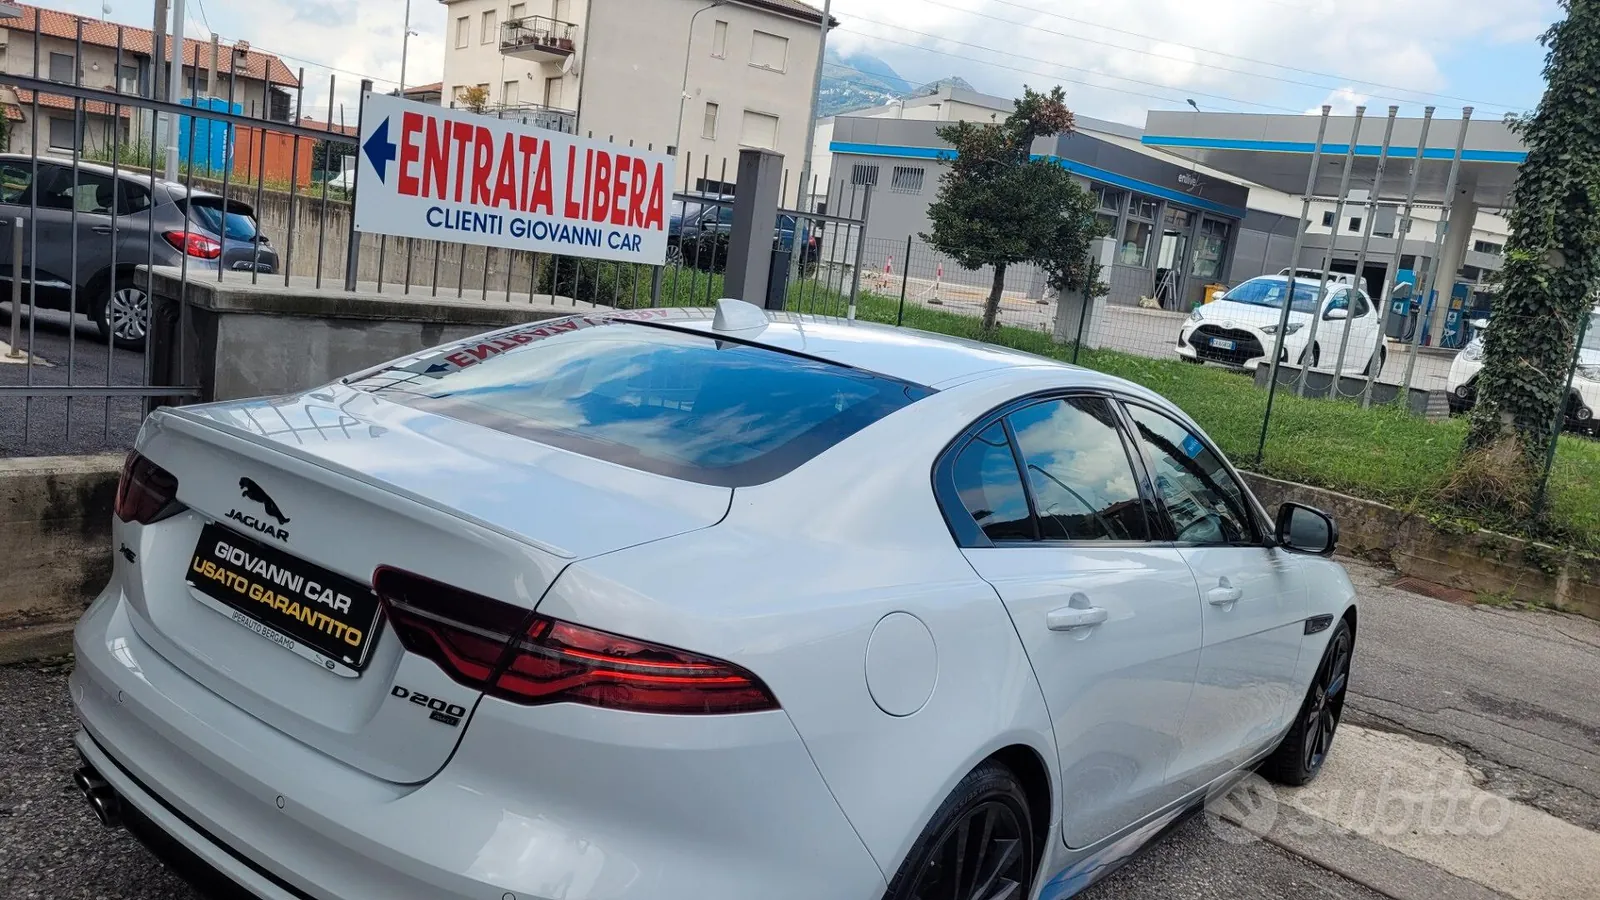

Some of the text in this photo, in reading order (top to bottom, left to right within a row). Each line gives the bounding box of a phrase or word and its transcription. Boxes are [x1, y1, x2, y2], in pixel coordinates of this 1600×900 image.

[398, 111, 664, 231] ENTRATA LIBERA
[426, 206, 642, 252] CLIENTI GIOVANNI CAR
[225, 509, 290, 542] JAGUAR
[193, 556, 363, 647] USATO GARANTITO
[214, 541, 351, 614] GIOVANNI CAR
[232, 610, 295, 650] IPERAUTO BERGAMO
